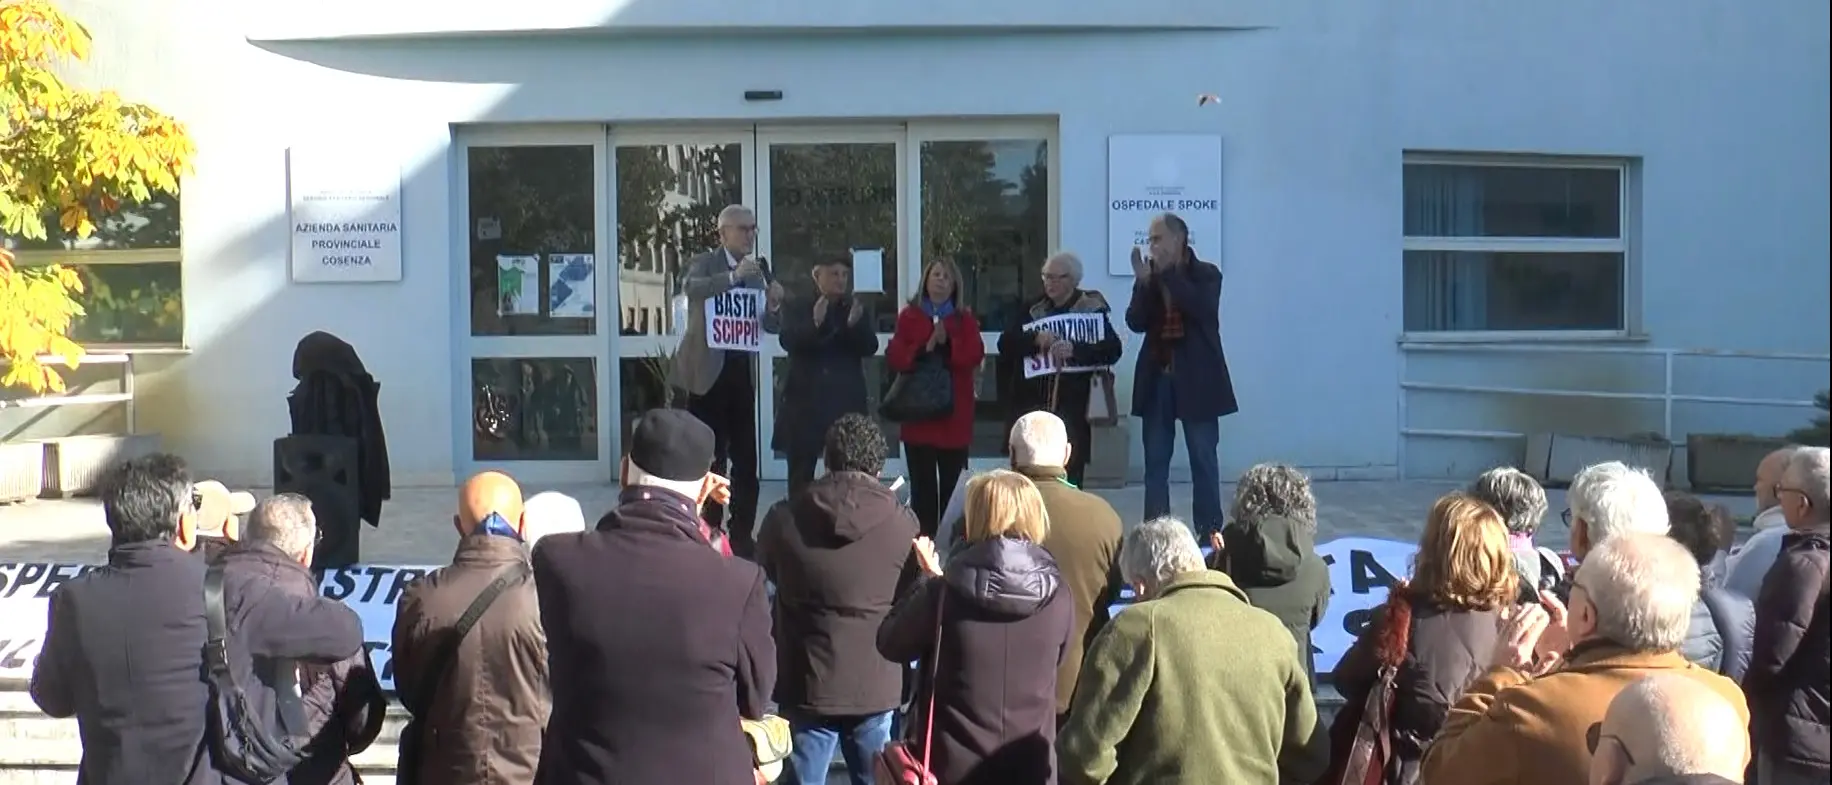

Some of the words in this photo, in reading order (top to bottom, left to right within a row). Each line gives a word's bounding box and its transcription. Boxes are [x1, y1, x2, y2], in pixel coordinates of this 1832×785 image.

[1112, 200, 1174, 211] OSPEDALE
[1178, 200, 1217, 210] SPOKE
[296, 223, 341, 233] AZIENDA
[343, 223, 397, 232] SANITARIA
[311, 240, 381, 249] PROVINCIALE
[322, 256, 371, 266] COSENZA
[714, 292, 757, 319] BASTA
[713, 319, 759, 347] SCIPPI!
